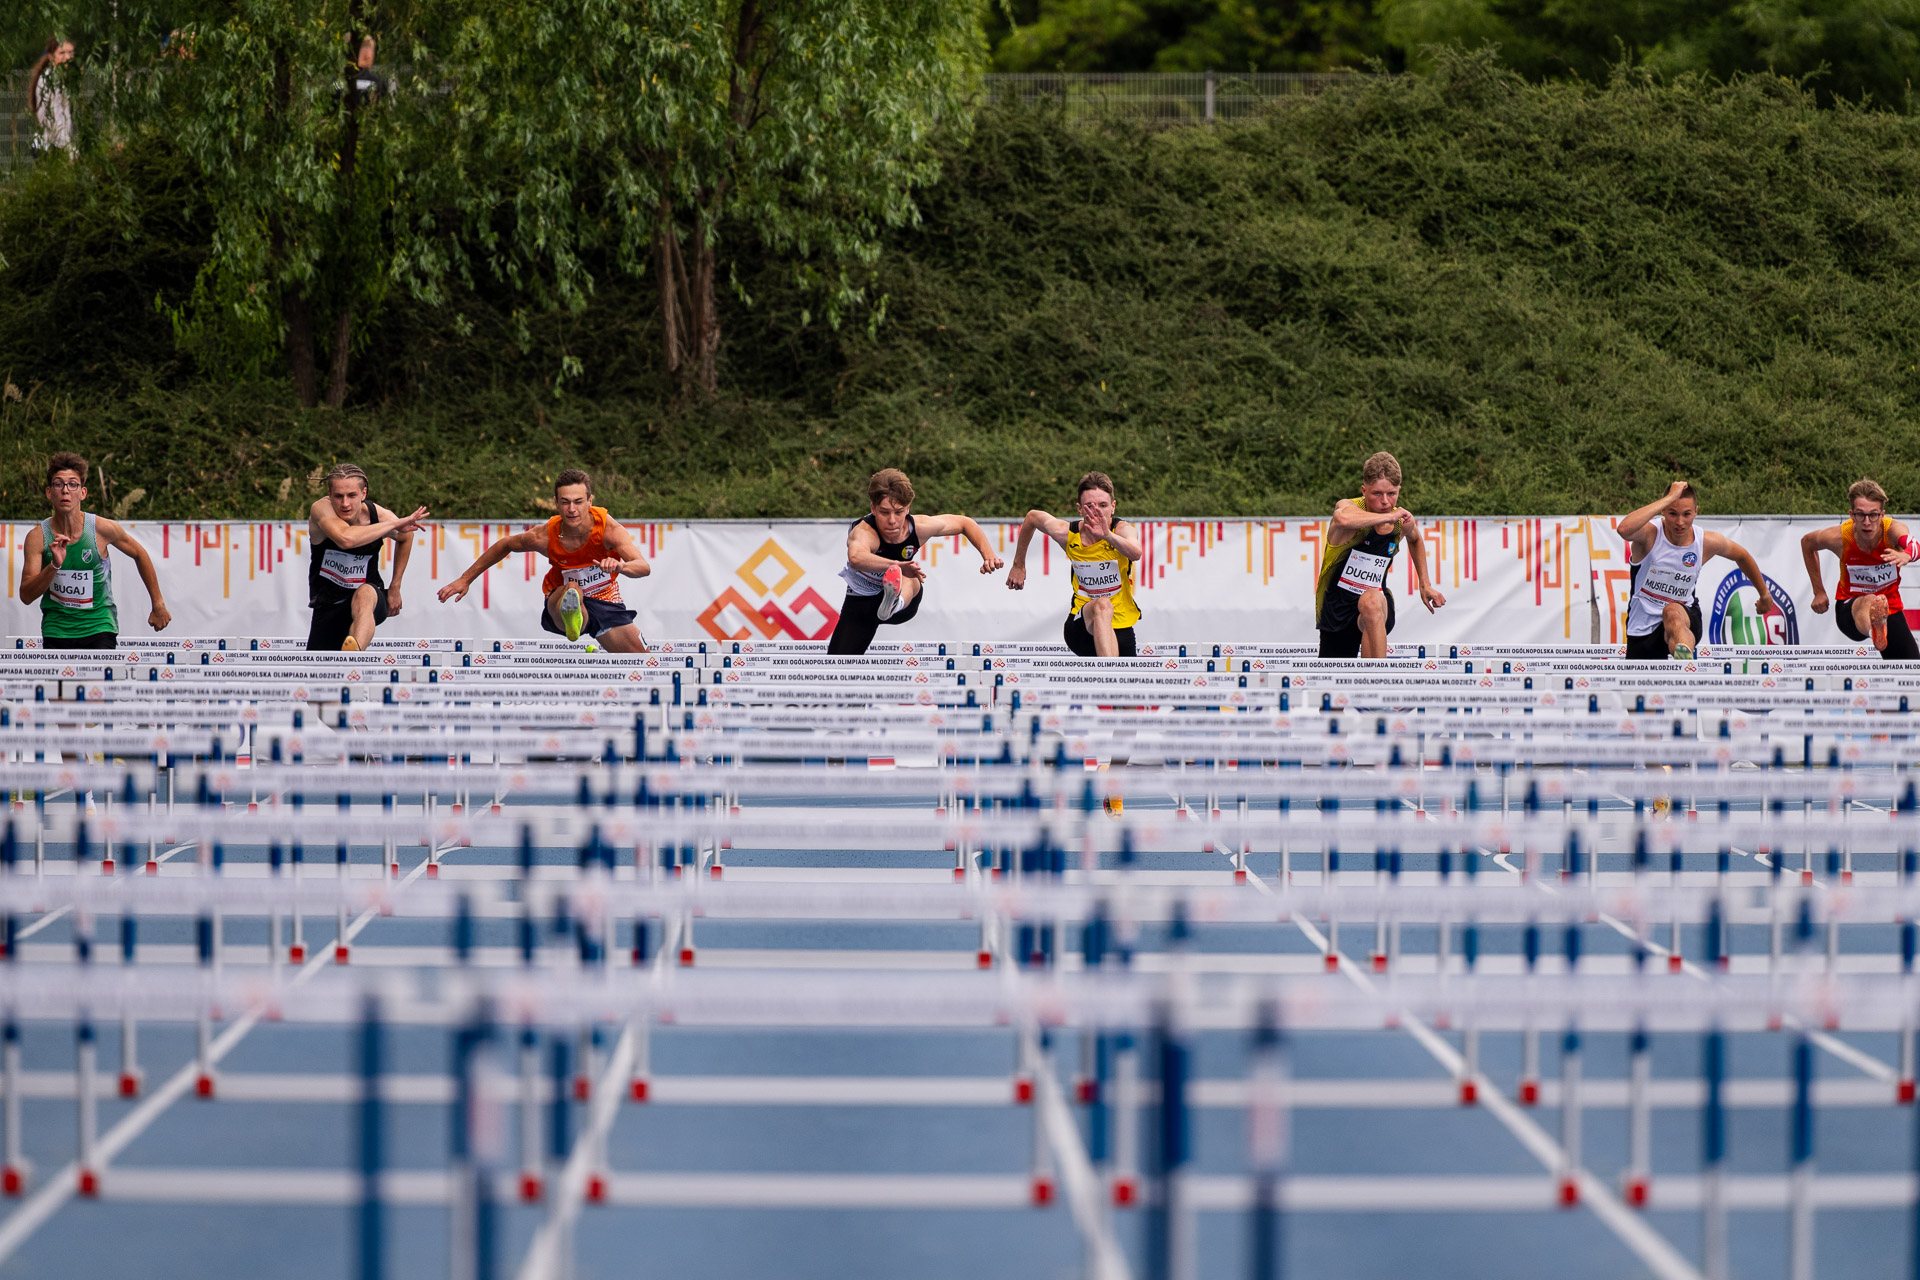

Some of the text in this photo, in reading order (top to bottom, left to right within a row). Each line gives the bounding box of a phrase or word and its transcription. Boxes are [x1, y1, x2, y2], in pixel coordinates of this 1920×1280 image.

[324, 558, 365, 575] KONDRATYK
[1099, 562, 1110, 570] 37
[1374, 559, 1387, 568] 951
[1077, 574, 1118, 586] KACZMAREK
[1674, 573, 1691, 583] 846
[1854, 571, 1892, 583] WOLNY
[54, 583, 85, 595] BUGAJ
[1645, 578, 1689, 597] MUSIELEWSKI
[1765, 580, 1793, 614] SPORTU
